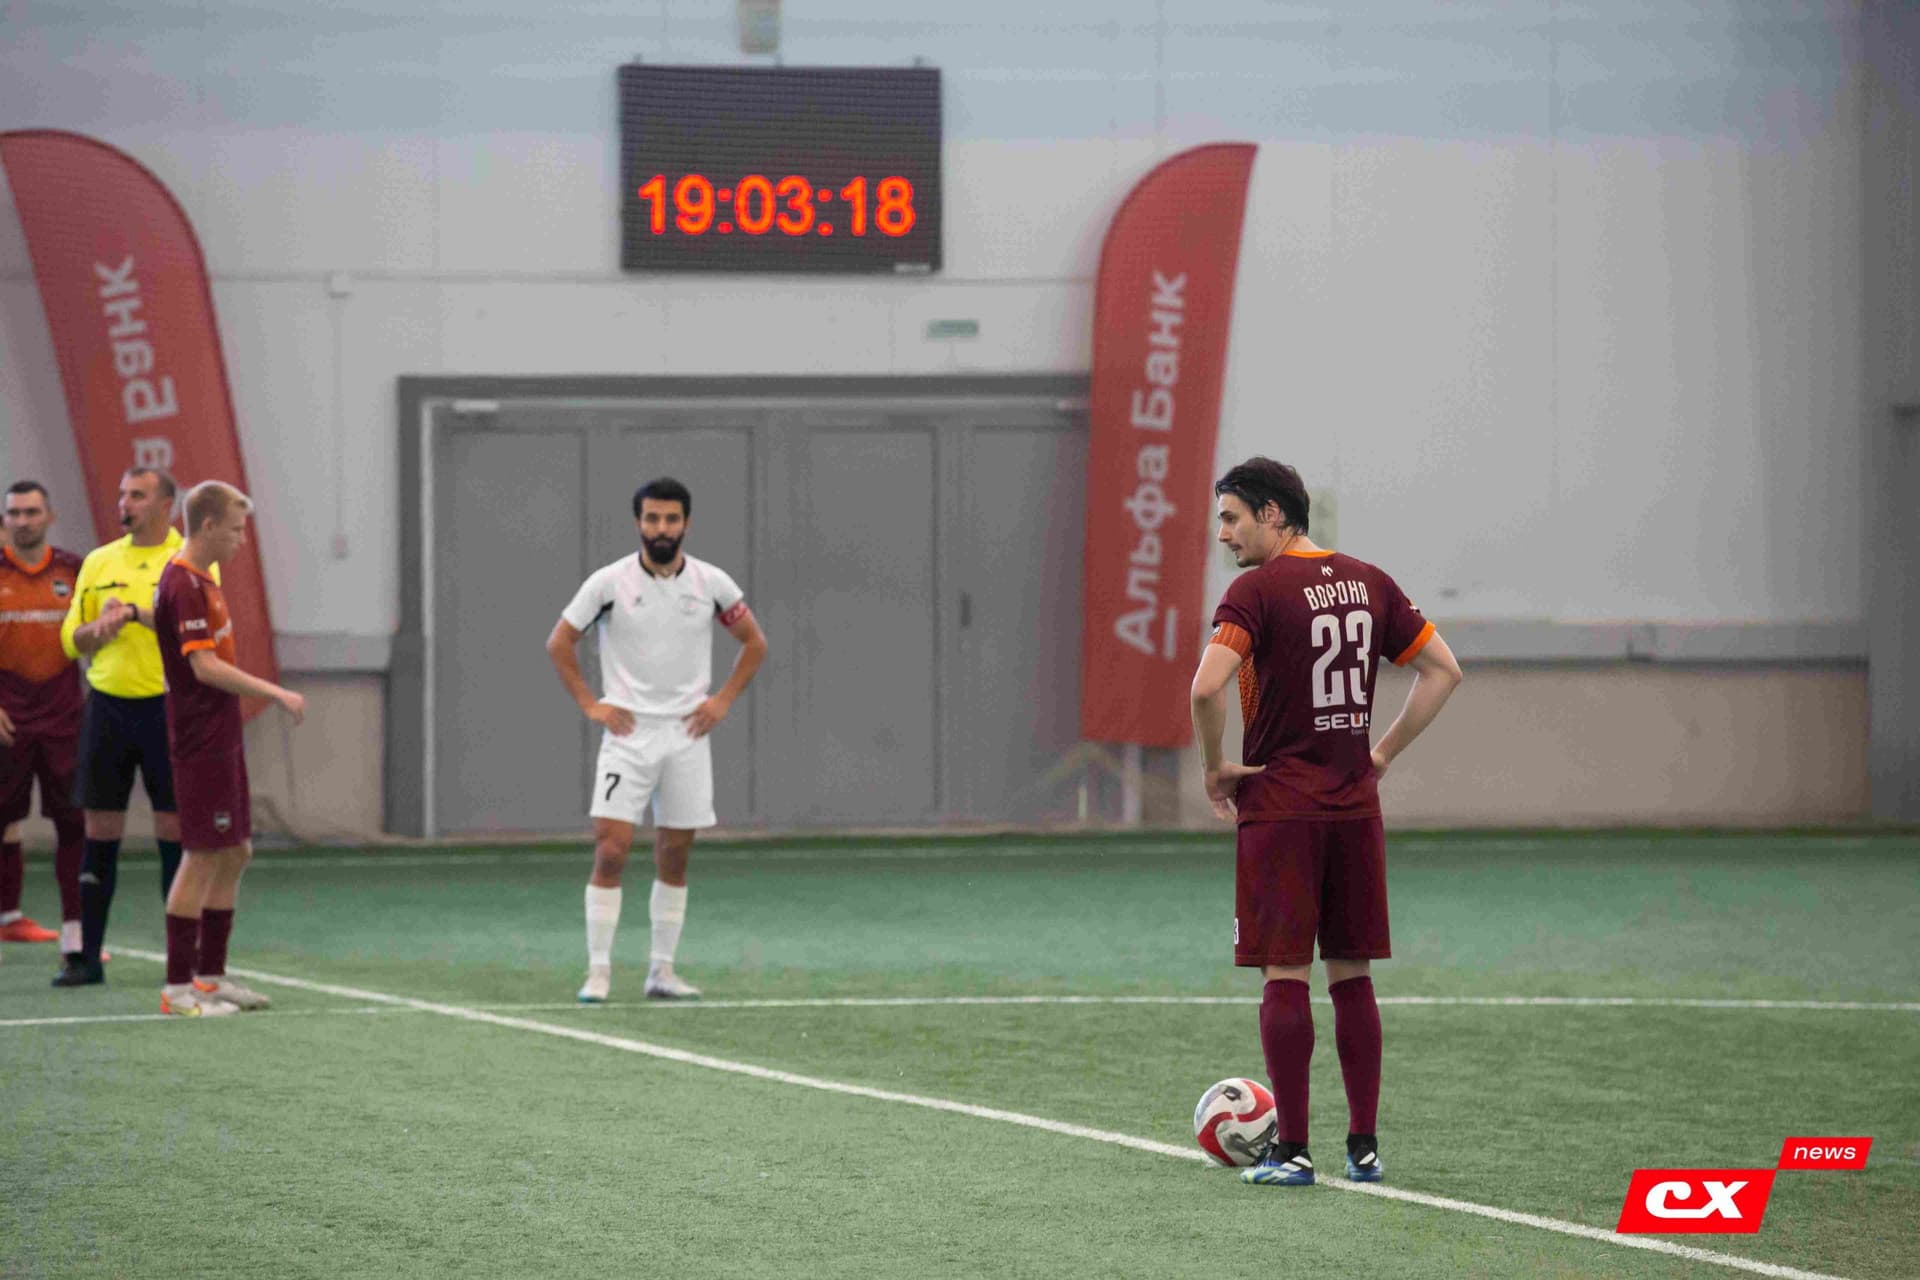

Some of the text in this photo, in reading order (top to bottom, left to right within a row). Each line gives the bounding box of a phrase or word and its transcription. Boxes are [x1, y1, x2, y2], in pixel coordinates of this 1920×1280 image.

[638, 174, 916, 237] 19:03:18
[1114, 271, 1187, 658] Альфа Банк
[1303, 580, 1369, 611] ВОРОНА
[1311, 610, 1373, 708] 23
[605, 773, 621, 801] 7
